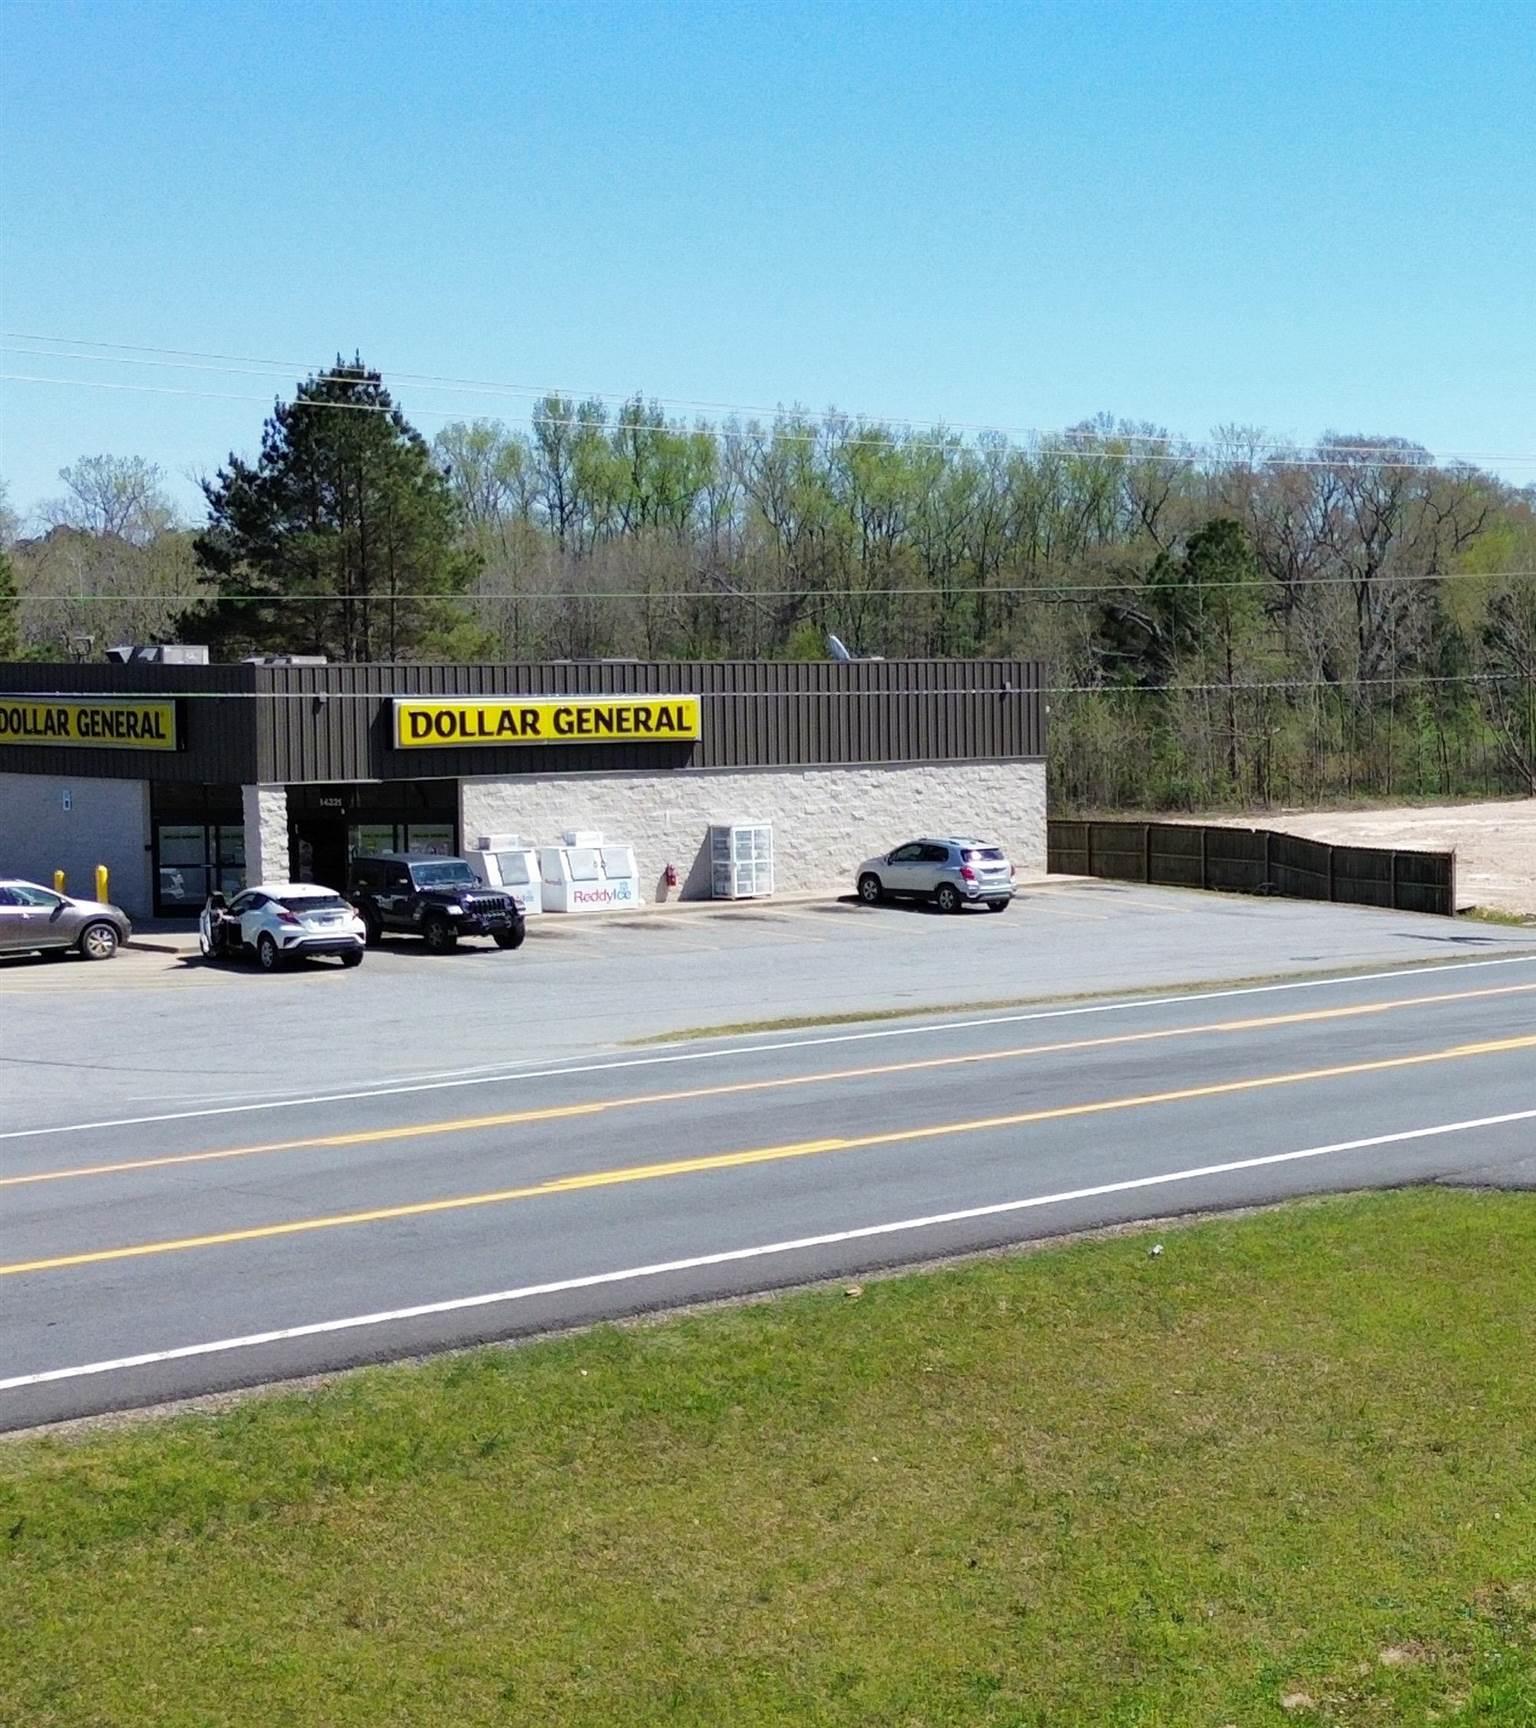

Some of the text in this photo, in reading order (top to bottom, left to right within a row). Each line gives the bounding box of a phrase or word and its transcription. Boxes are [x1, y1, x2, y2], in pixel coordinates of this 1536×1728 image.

[77, 709, 166, 739] GENERAL
[408, 705, 692, 738] DOLLAR GENERAL
